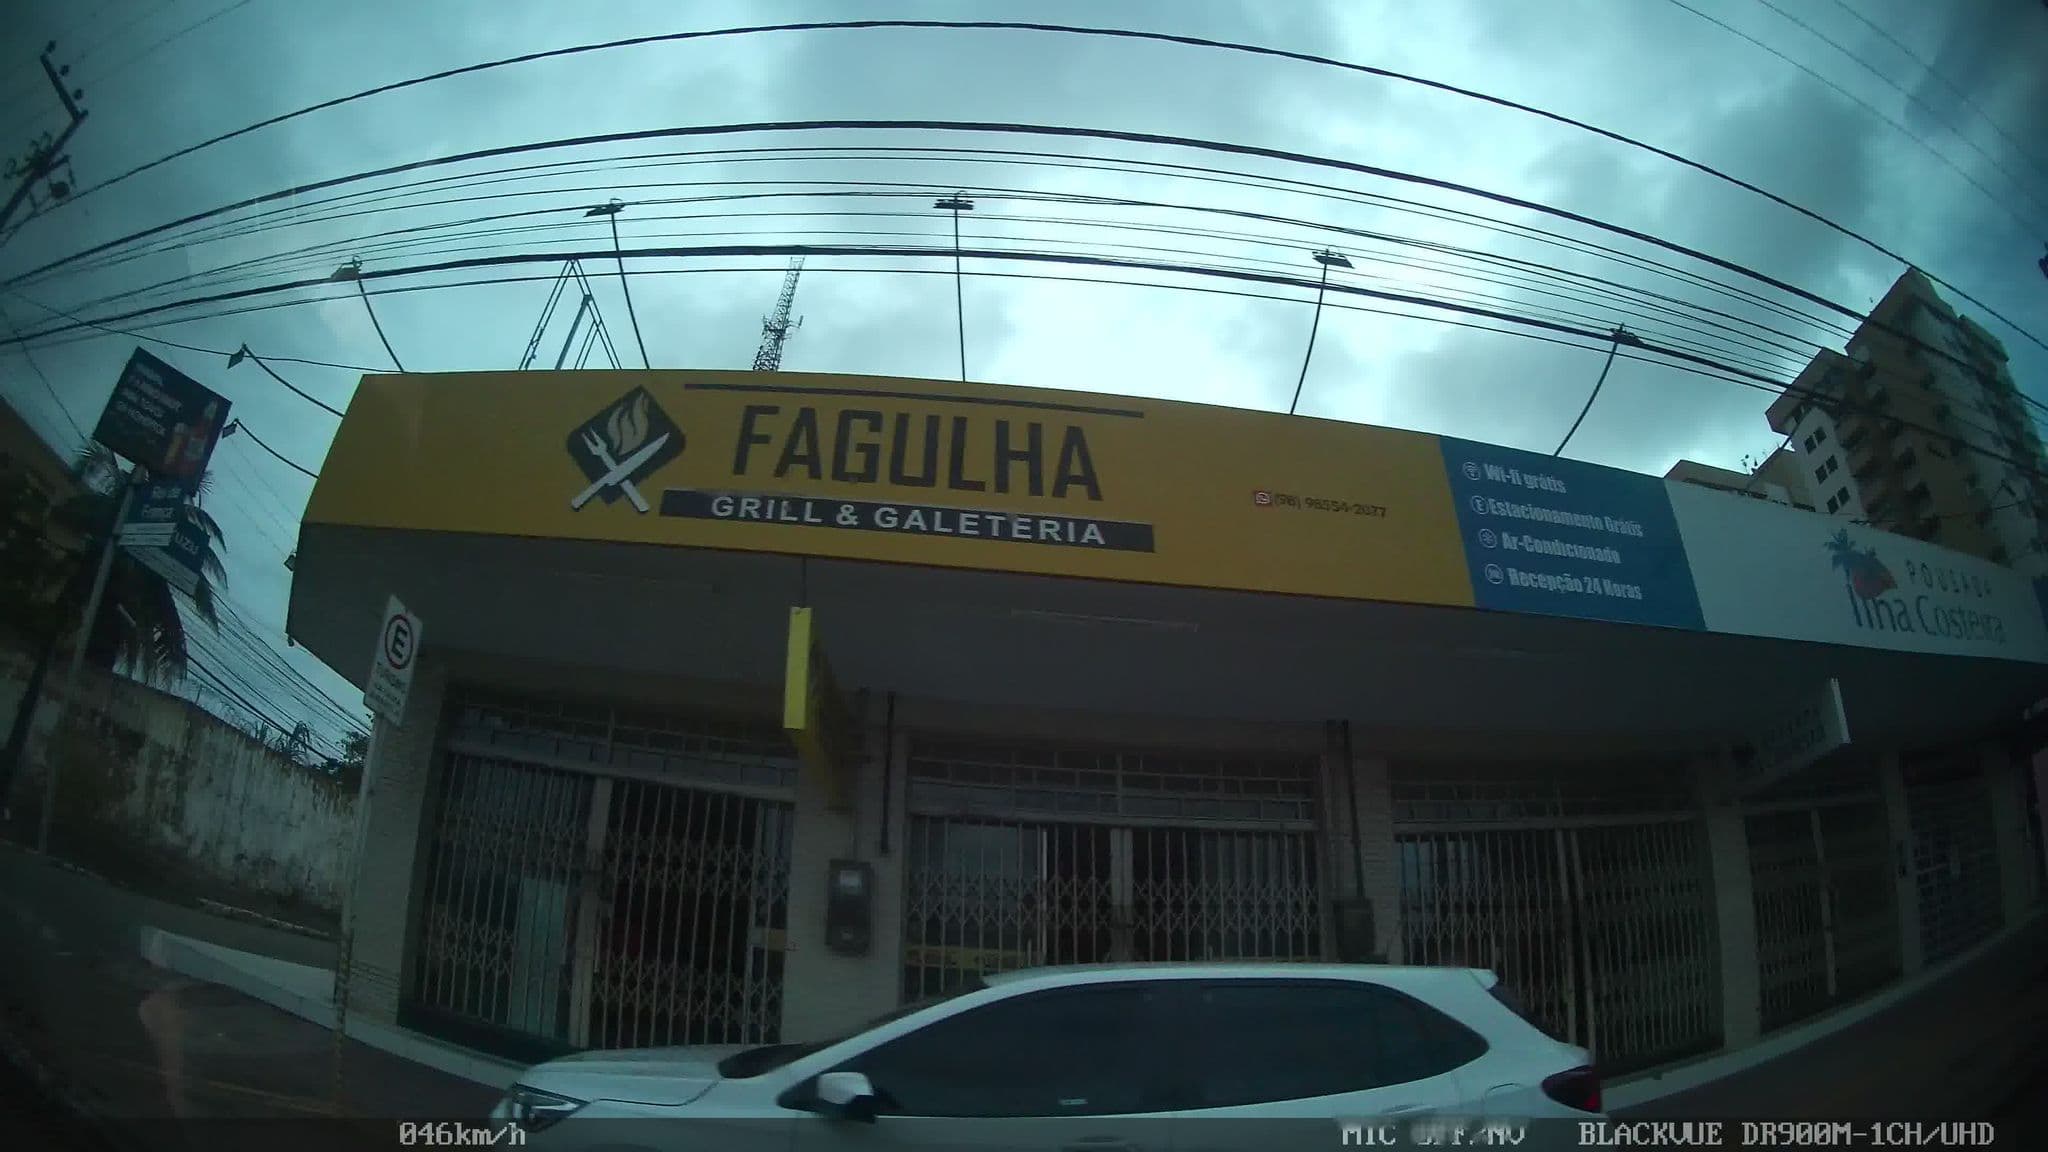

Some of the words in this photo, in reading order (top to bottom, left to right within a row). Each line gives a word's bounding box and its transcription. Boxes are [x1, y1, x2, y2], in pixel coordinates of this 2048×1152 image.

[732, 404, 1103, 501] FAGULHA
[711, 495, 823, 525] GRILL
[836, 504, 859, 527] &
[874, 506, 1107, 546] GALETERIA
[1487, 498, 1604, 530] Estacionamento
[1604, 515, 1643, 537] Grátis
[1502, 531, 1621, 564] Ar-Condicionado
[1507, 567, 1583, 593] Recepção
[1584, 575, 1602, 595] 24
[1602, 578, 1643, 600] Horas
[391, 623, 408, 659] E
